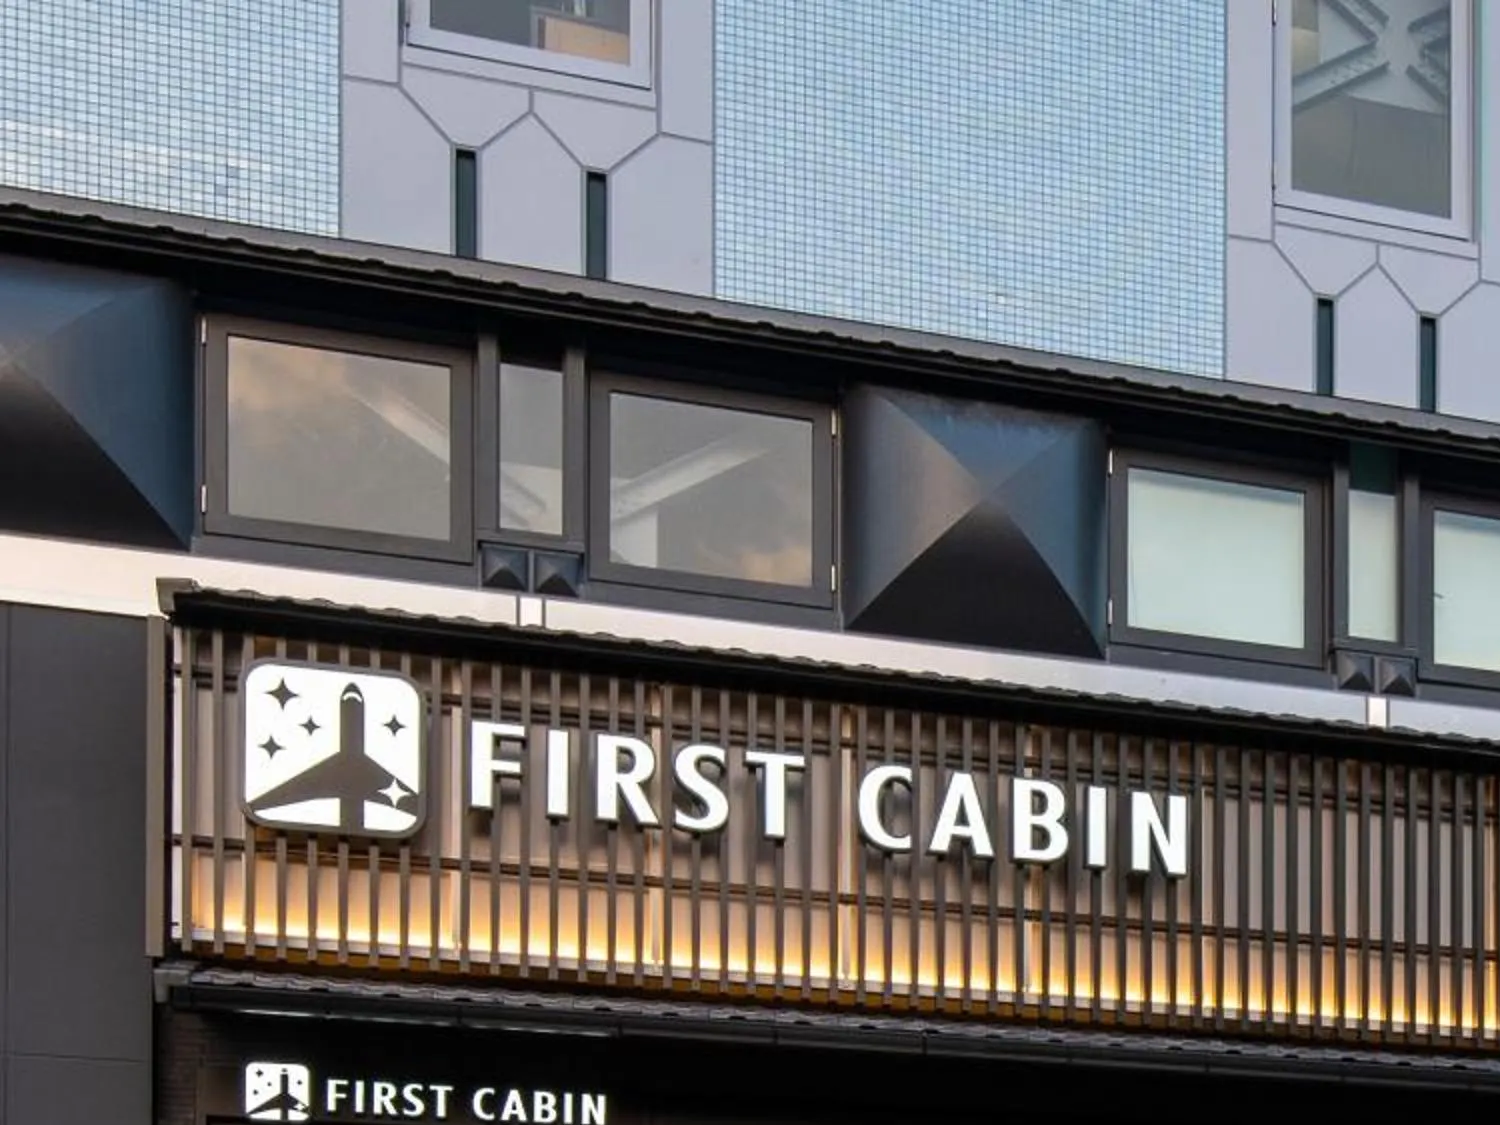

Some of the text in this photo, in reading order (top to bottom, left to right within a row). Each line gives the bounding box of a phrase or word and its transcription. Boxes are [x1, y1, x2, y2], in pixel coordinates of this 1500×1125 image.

[467, 720, 1190, 878] FIRST CABIN
[326, 1079, 454, 1118] FIRST
